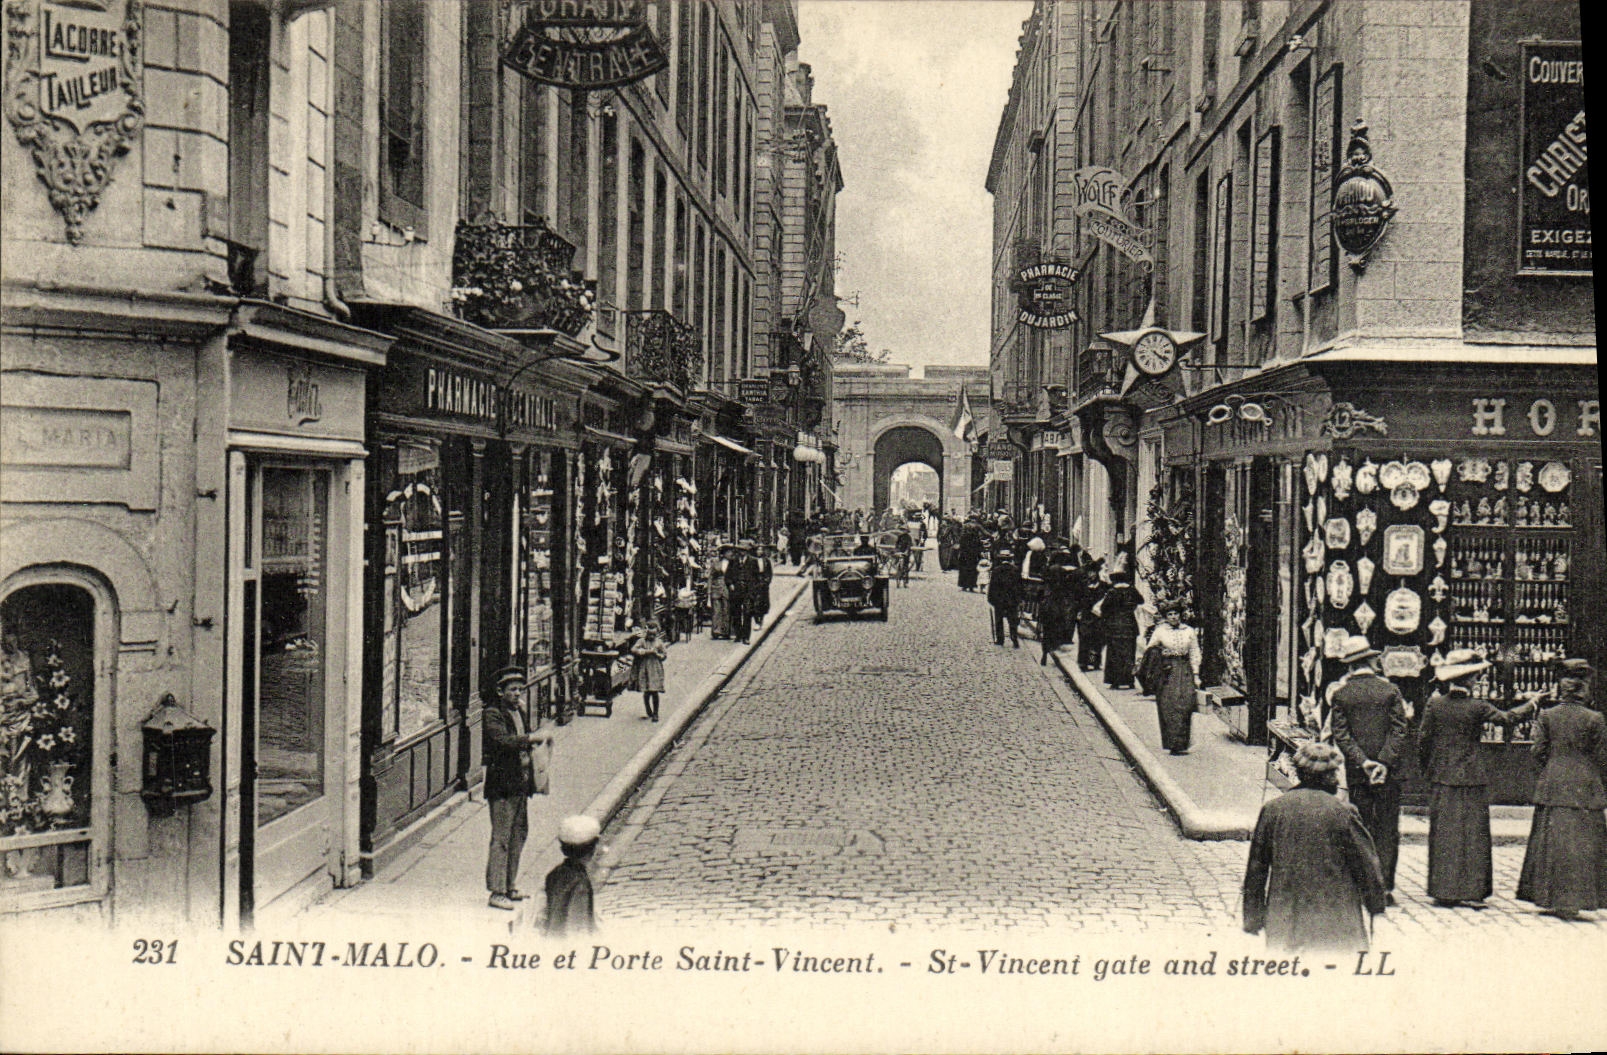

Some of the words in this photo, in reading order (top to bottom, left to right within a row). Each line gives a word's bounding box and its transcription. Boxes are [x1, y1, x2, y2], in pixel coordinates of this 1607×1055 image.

[40, 66, 117, 111] TAILLEUR
[1020, 265, 1079, 281] PHARMACIE
[1020, 310, 1078, 327] DUJARDIN
[427, 367, 497, 419] PHARMACIE
